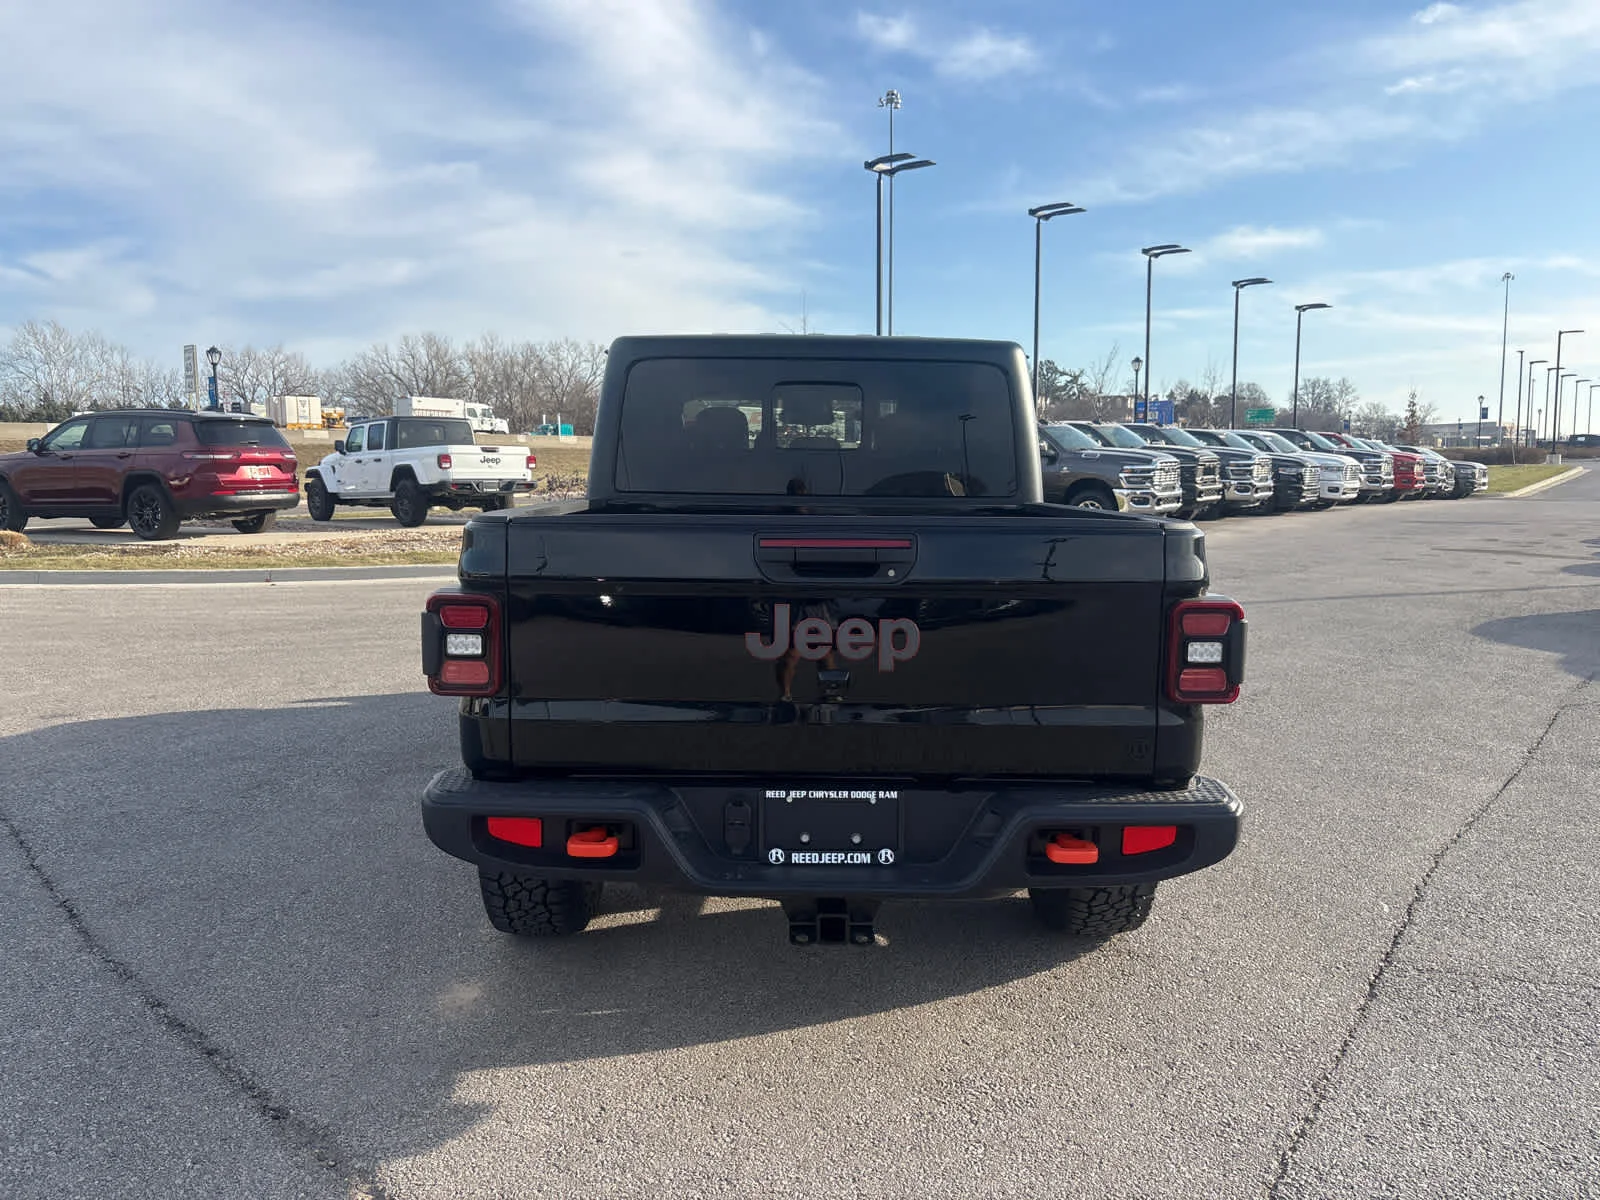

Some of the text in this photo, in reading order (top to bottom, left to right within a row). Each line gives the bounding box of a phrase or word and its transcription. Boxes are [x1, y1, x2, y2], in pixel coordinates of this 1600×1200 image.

[480, 456, 501, 465] Jeep
[744, 603, 921, 672] Jeep
[766, 790, 898, 799] REED JEEP CHRYSLER DODGE RAM
[791, 852, 871, 864] REEDJEEP.COM
